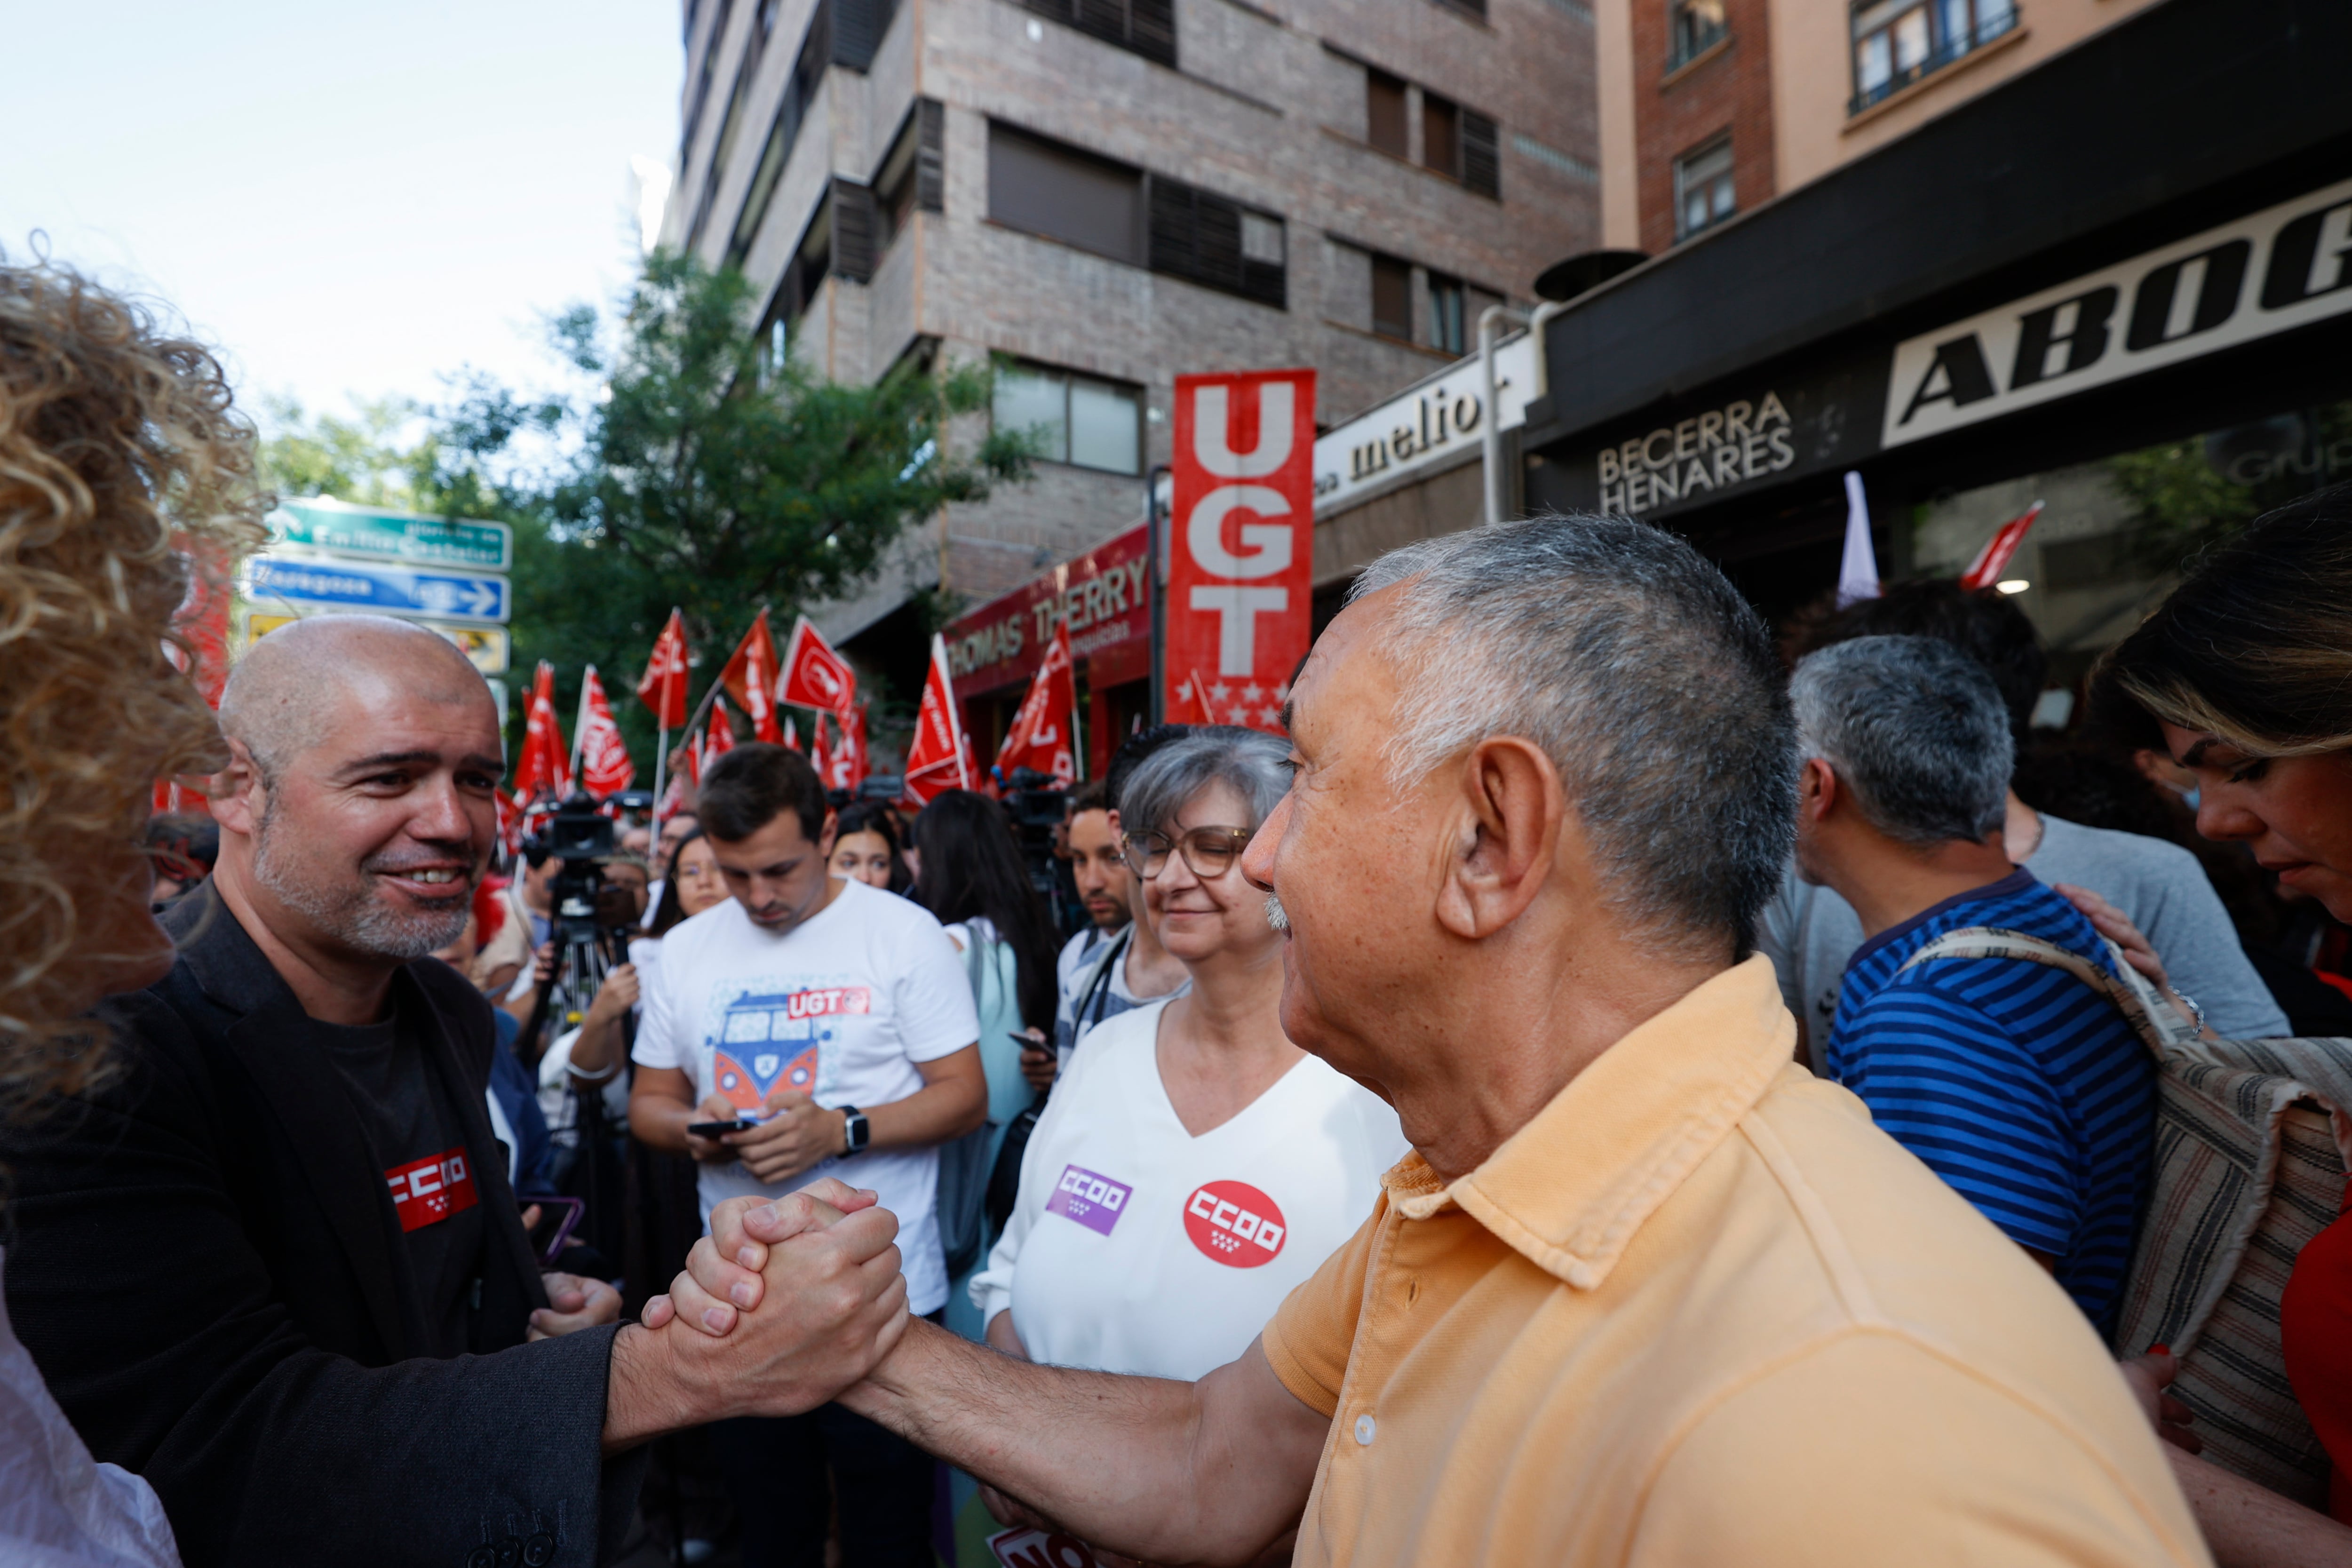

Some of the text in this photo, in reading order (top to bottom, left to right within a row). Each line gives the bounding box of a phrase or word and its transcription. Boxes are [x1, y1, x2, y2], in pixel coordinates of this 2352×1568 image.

[1349, 376, 1511, 481] melio
[1597, 390, 1791, 486] BECERRA
[1600, 426, 1795, 517] HENARES
[1187, 382, 1295, 676] UGT
[1032, 554, 1150, 644] THERRY
[789, 990, 842, 1017] UGT
[1059, 1170, 1127, 1212] CCOO
[1188, 1189, 1285, 1252] CCOO
